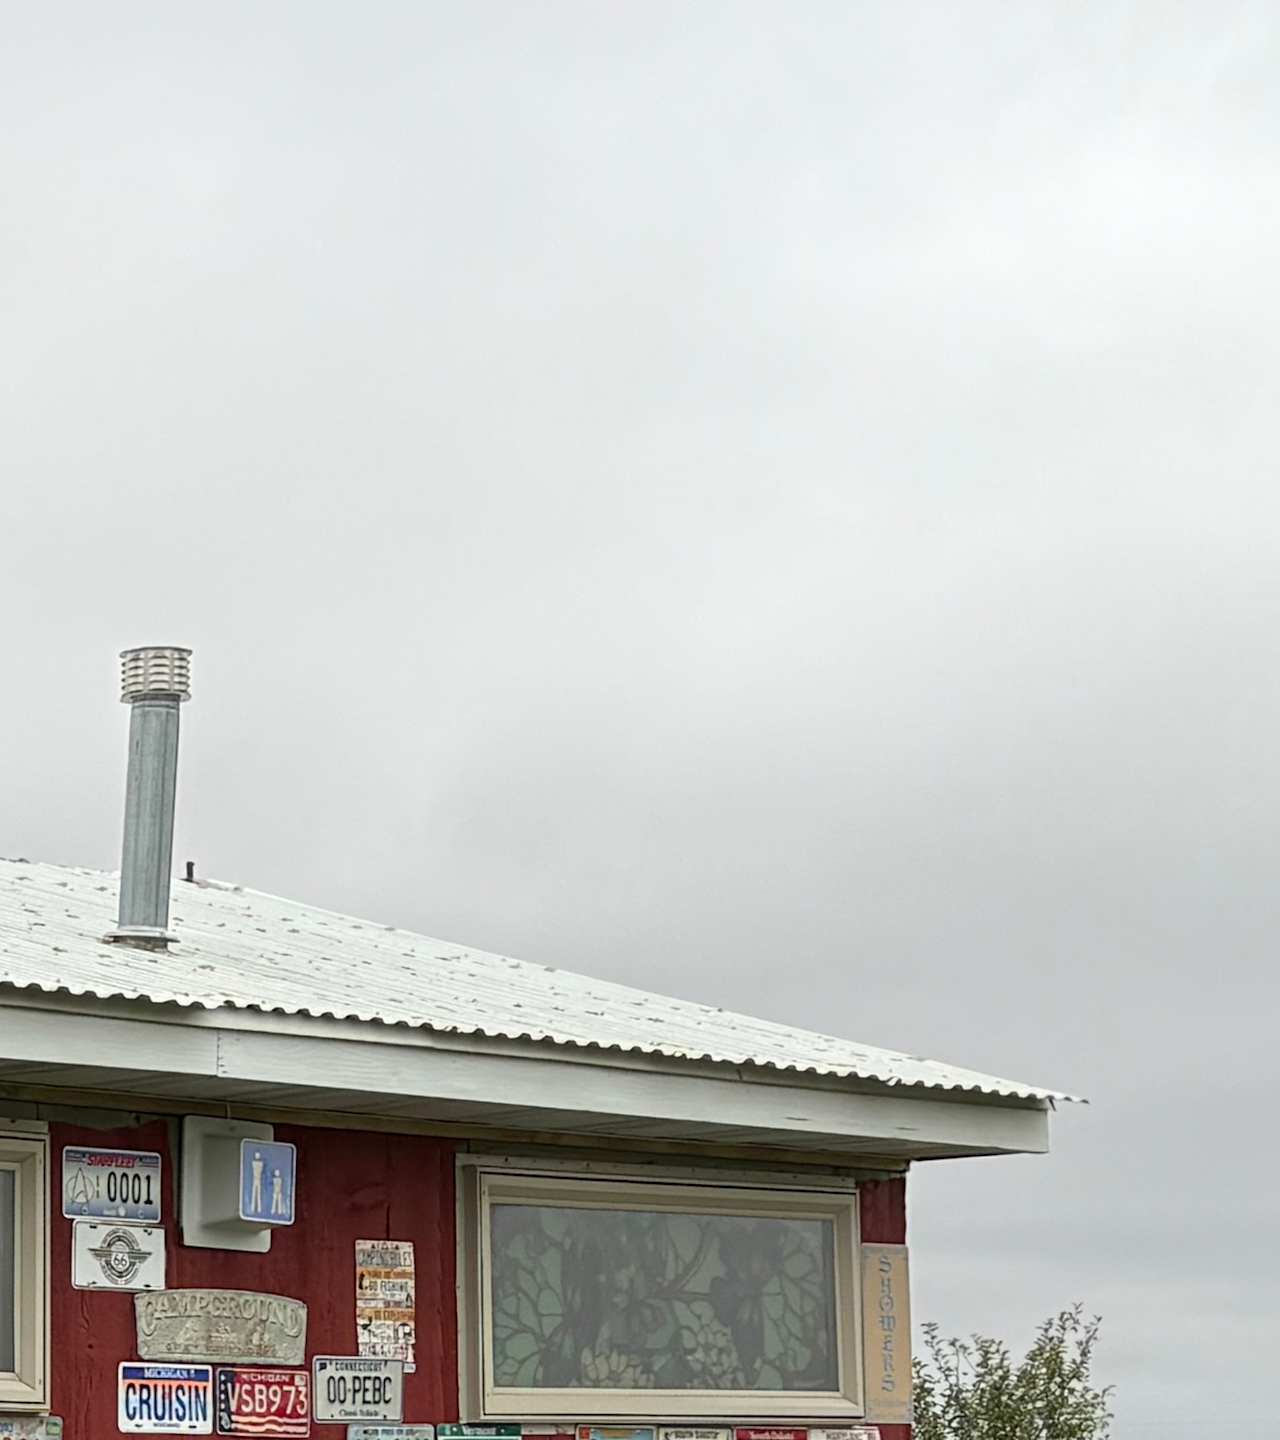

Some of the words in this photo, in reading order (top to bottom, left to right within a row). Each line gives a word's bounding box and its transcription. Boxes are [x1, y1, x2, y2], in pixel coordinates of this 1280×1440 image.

[107, 1171, 153, 1205] 0001
[113, 1254, 127, 1266] 66
[142, 1295, 303, 1338] CAMPGROUND
[240, 1373, 290, 1382] MICHIGAN
[125, 1382, 208, 1422] CRUISIN
[228, 1382, 308, 1415] VSB973
